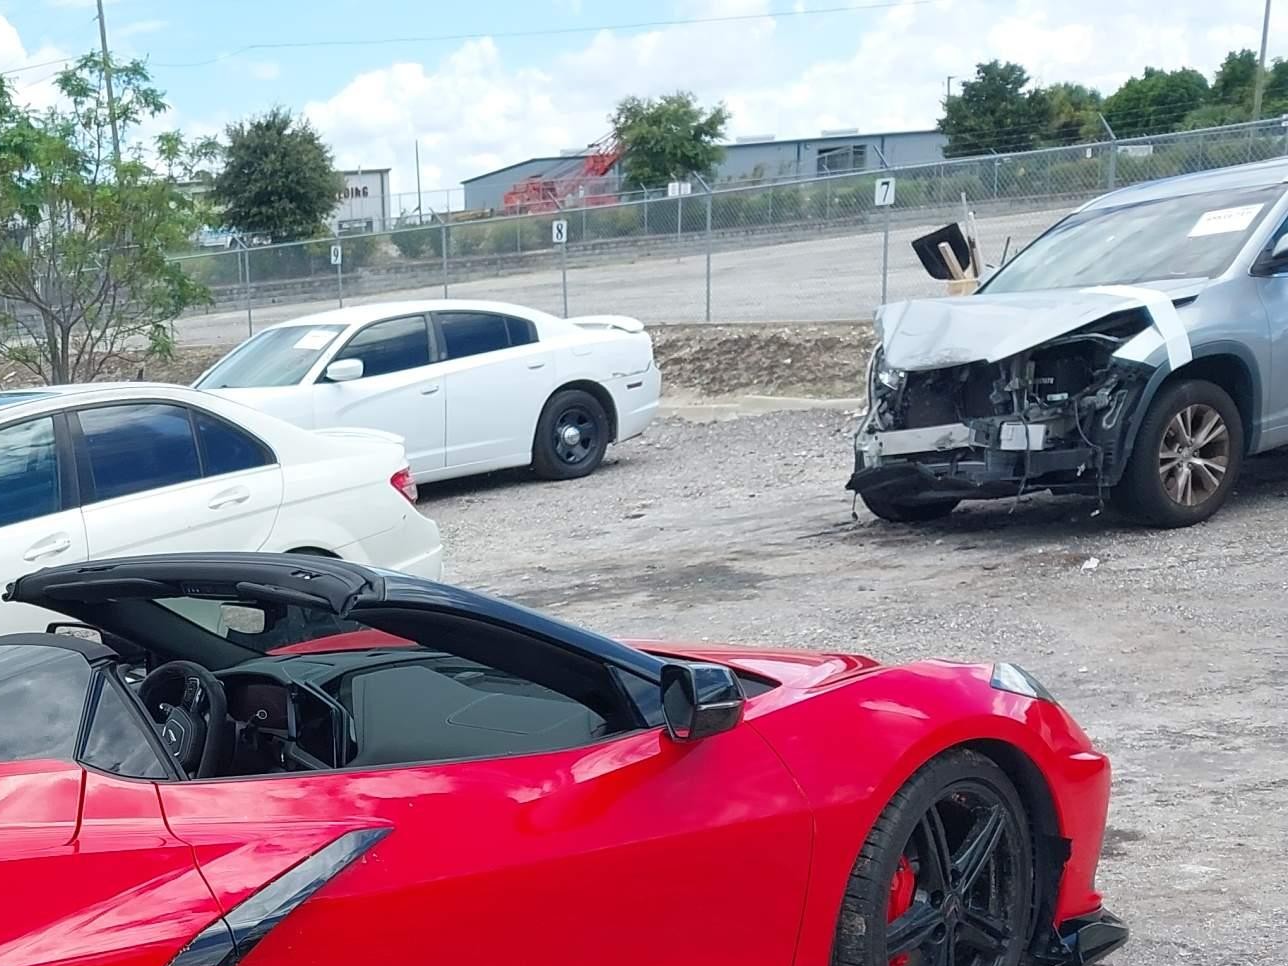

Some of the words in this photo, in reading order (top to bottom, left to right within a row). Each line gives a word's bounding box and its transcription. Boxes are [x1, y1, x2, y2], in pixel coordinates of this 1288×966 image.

[881, 181, 890, 203] 7
[556, 223, 564, 241] 8
[333, 247, 340, 262] 9
